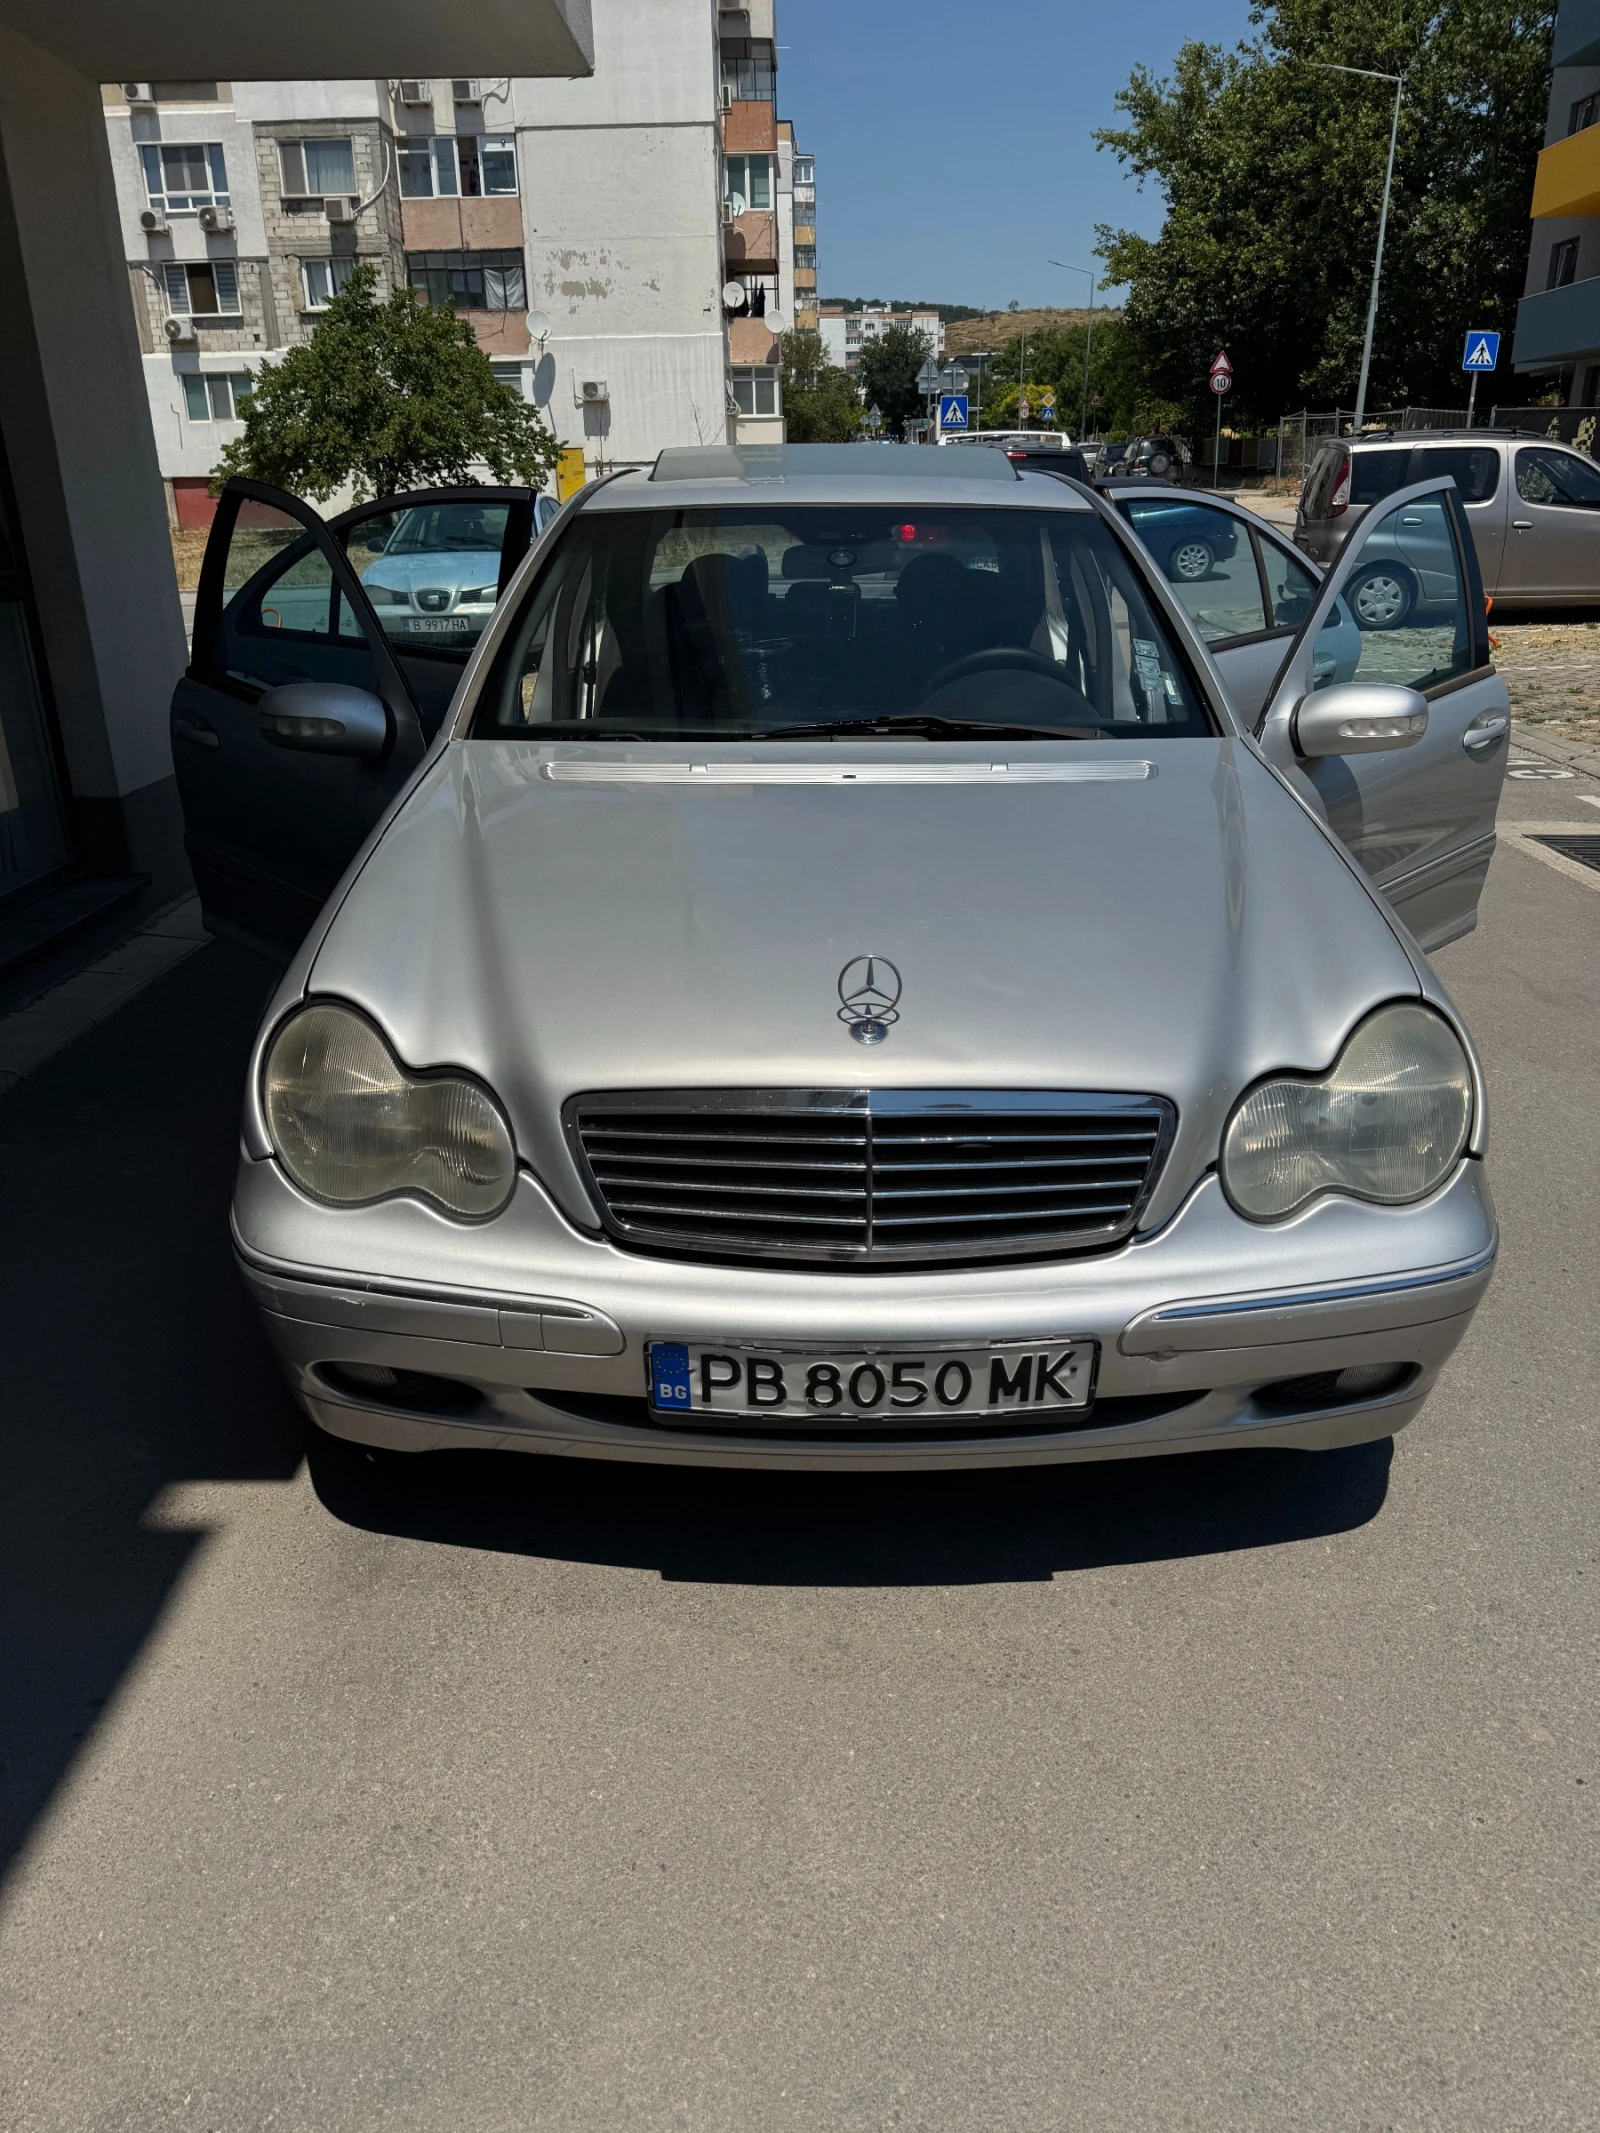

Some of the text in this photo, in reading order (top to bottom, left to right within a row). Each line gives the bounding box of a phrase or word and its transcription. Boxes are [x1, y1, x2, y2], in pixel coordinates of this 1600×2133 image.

[1216, 378, 1226, 389] 10
[413, 620, 420, 631] B
[452, 619, 467, 631] HA
[701, 1351, 1077, 1409] PB 8050 MK
[660, 1383, 687, 1399] BG
